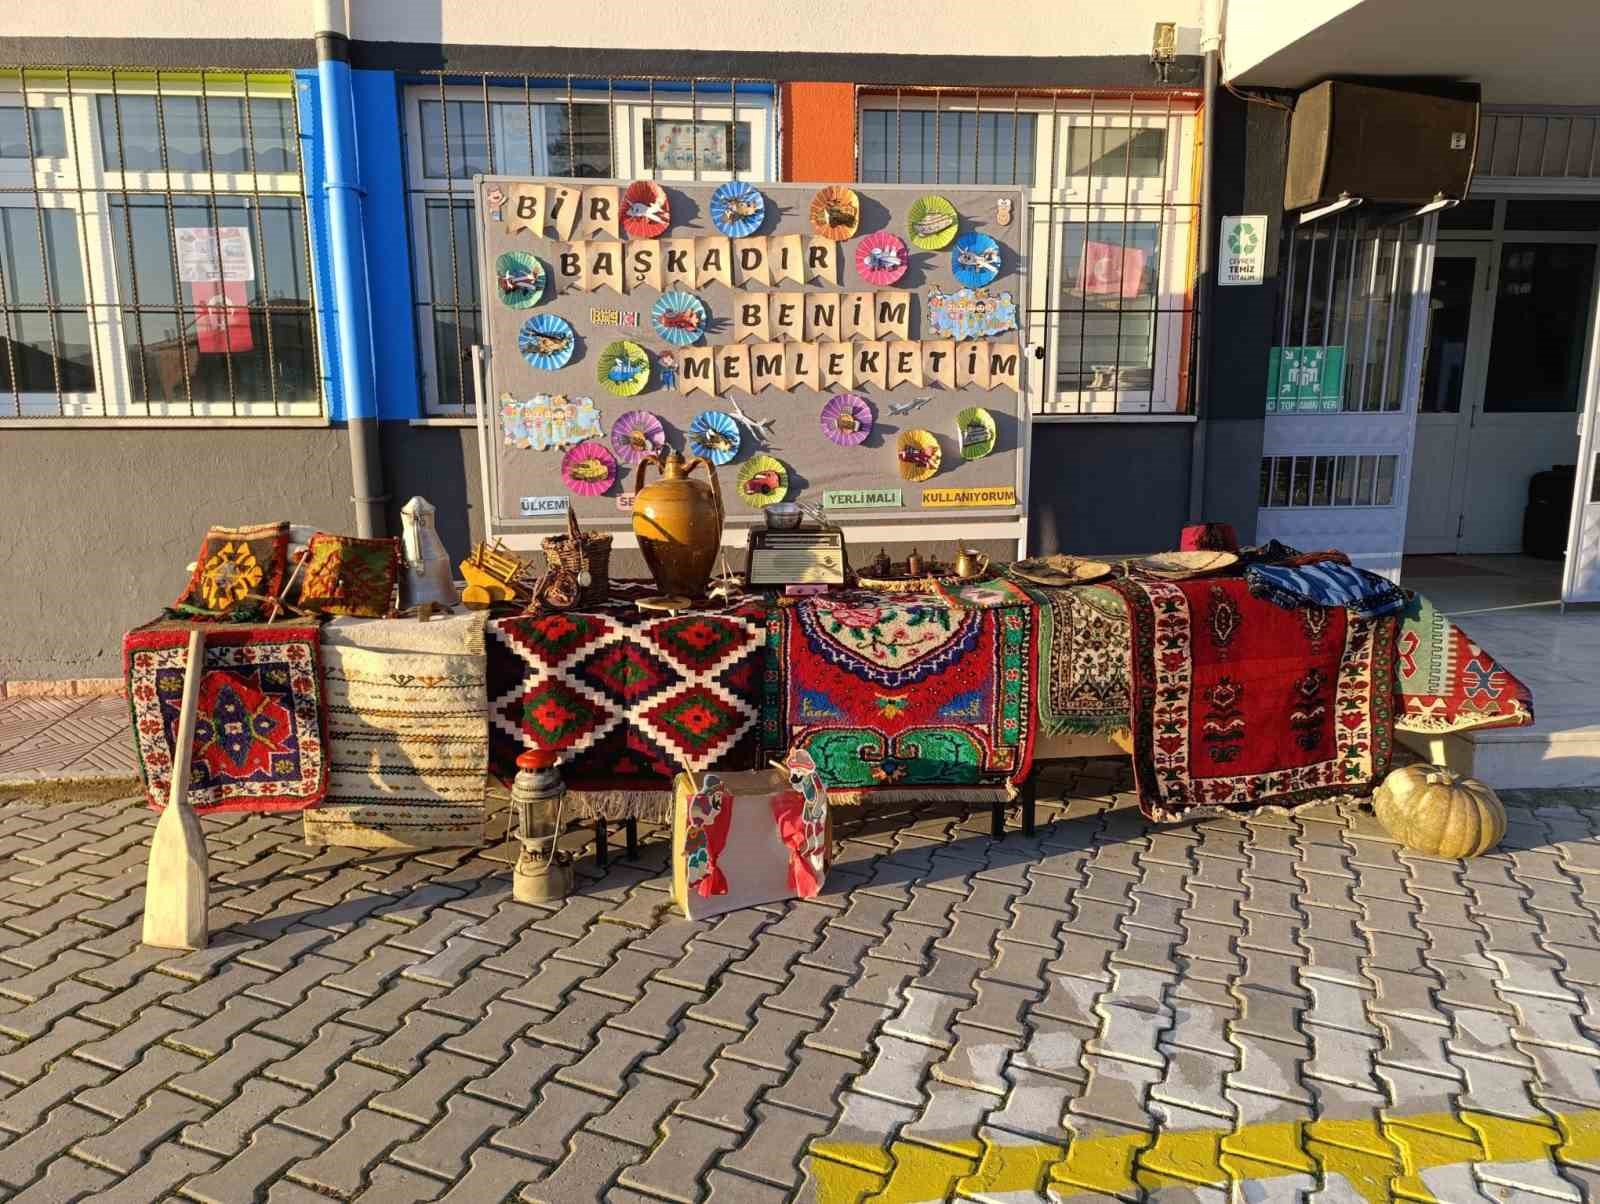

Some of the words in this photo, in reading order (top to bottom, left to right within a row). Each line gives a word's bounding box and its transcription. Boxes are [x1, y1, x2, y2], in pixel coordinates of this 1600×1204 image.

[516, 190, 611, 221] BİR
[560, 245, 829, 281] BAŞKADIR
[741, 296, 908, 327] BENİM
[683, 346, 1017, 379] MEMLEKETİM
[829, 492, 865, 504] YERLİ
[866, 492, 896, 504] MALI
[922, 491, 1015, 504] KULLANIYORUM
